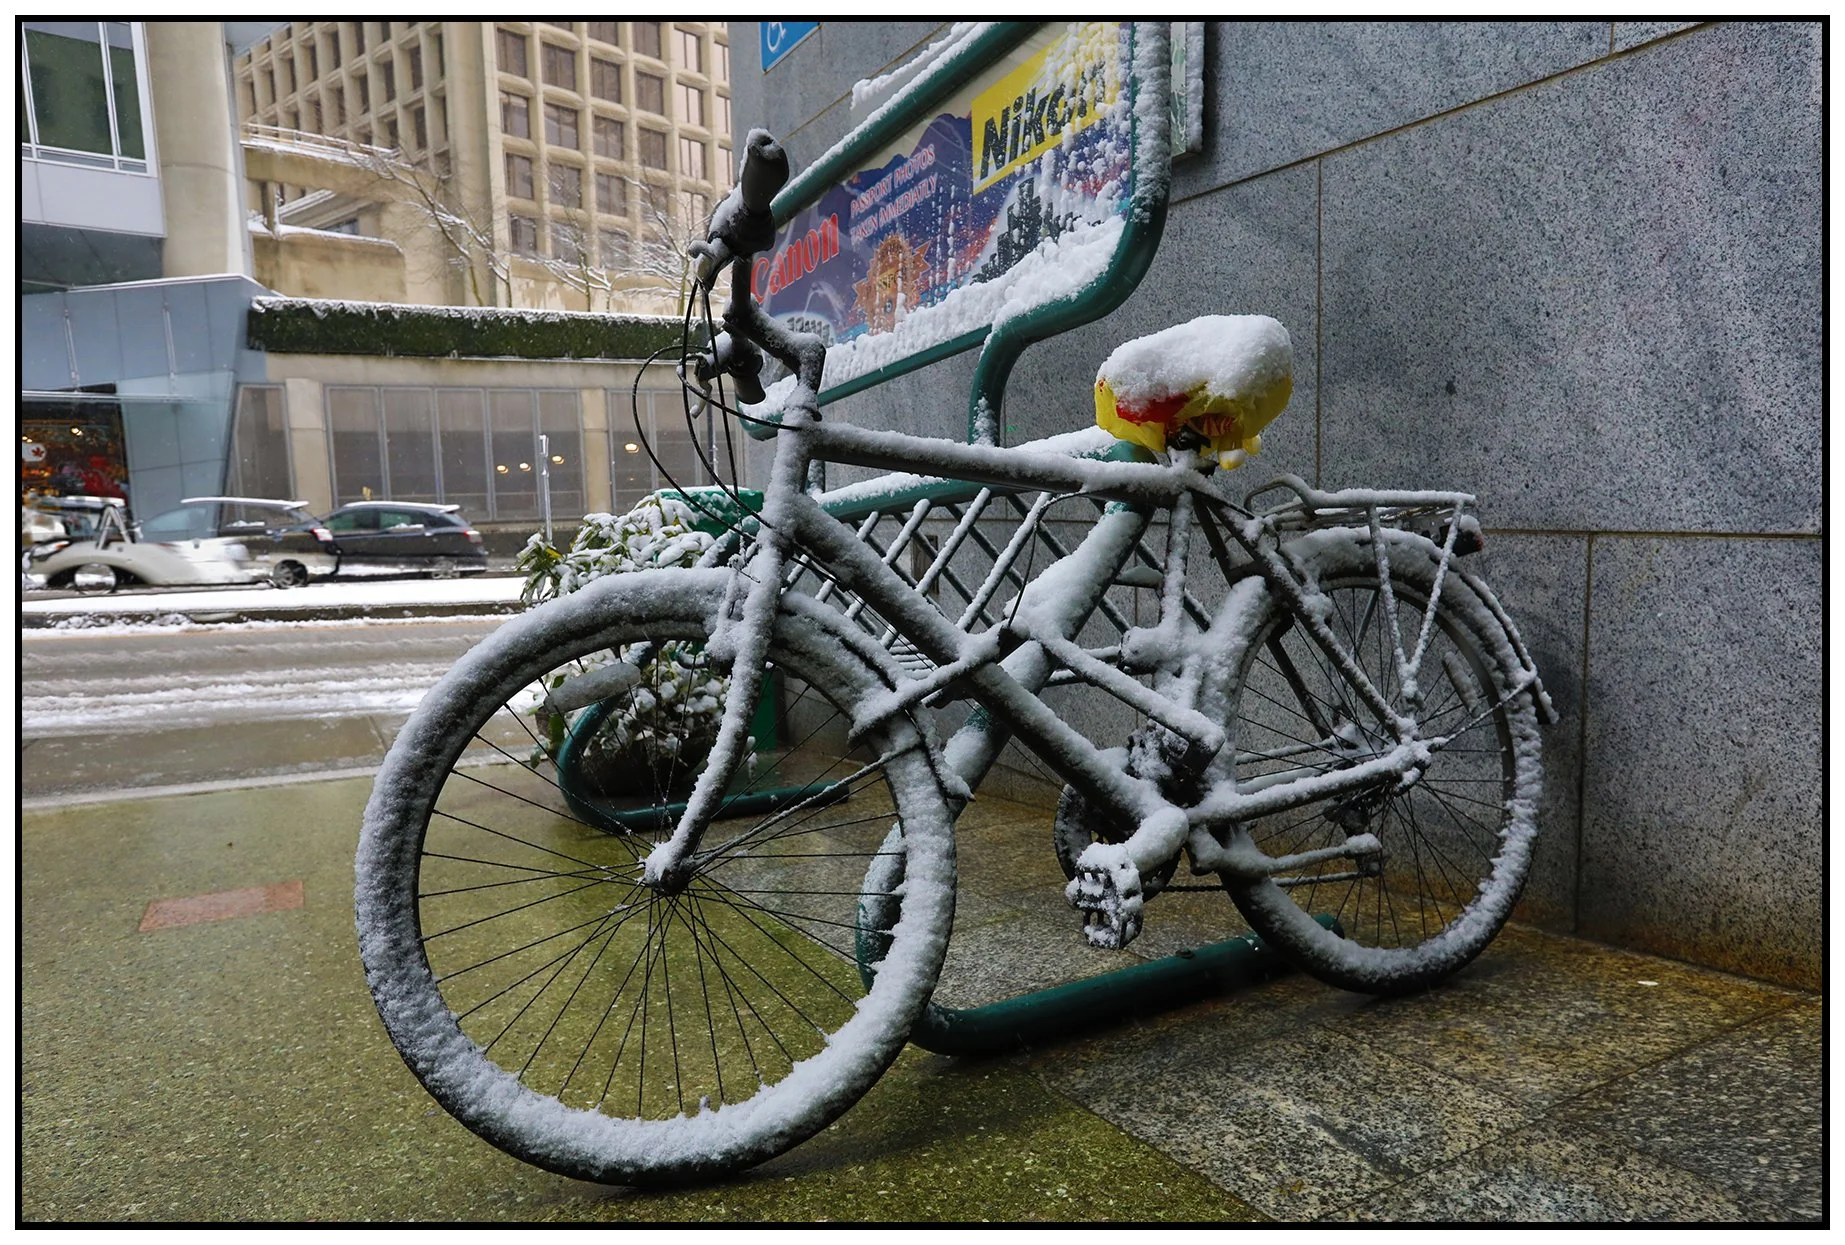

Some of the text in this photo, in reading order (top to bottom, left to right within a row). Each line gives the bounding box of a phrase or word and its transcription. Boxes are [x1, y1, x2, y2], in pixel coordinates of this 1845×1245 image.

[980, 61, 1105, 179] Nikon
[851, 144, 935, 218] PASSPORT PHOTOS
[750, 212, 839, 305] Canon
[850, 213, 878, 246] TAKEN
